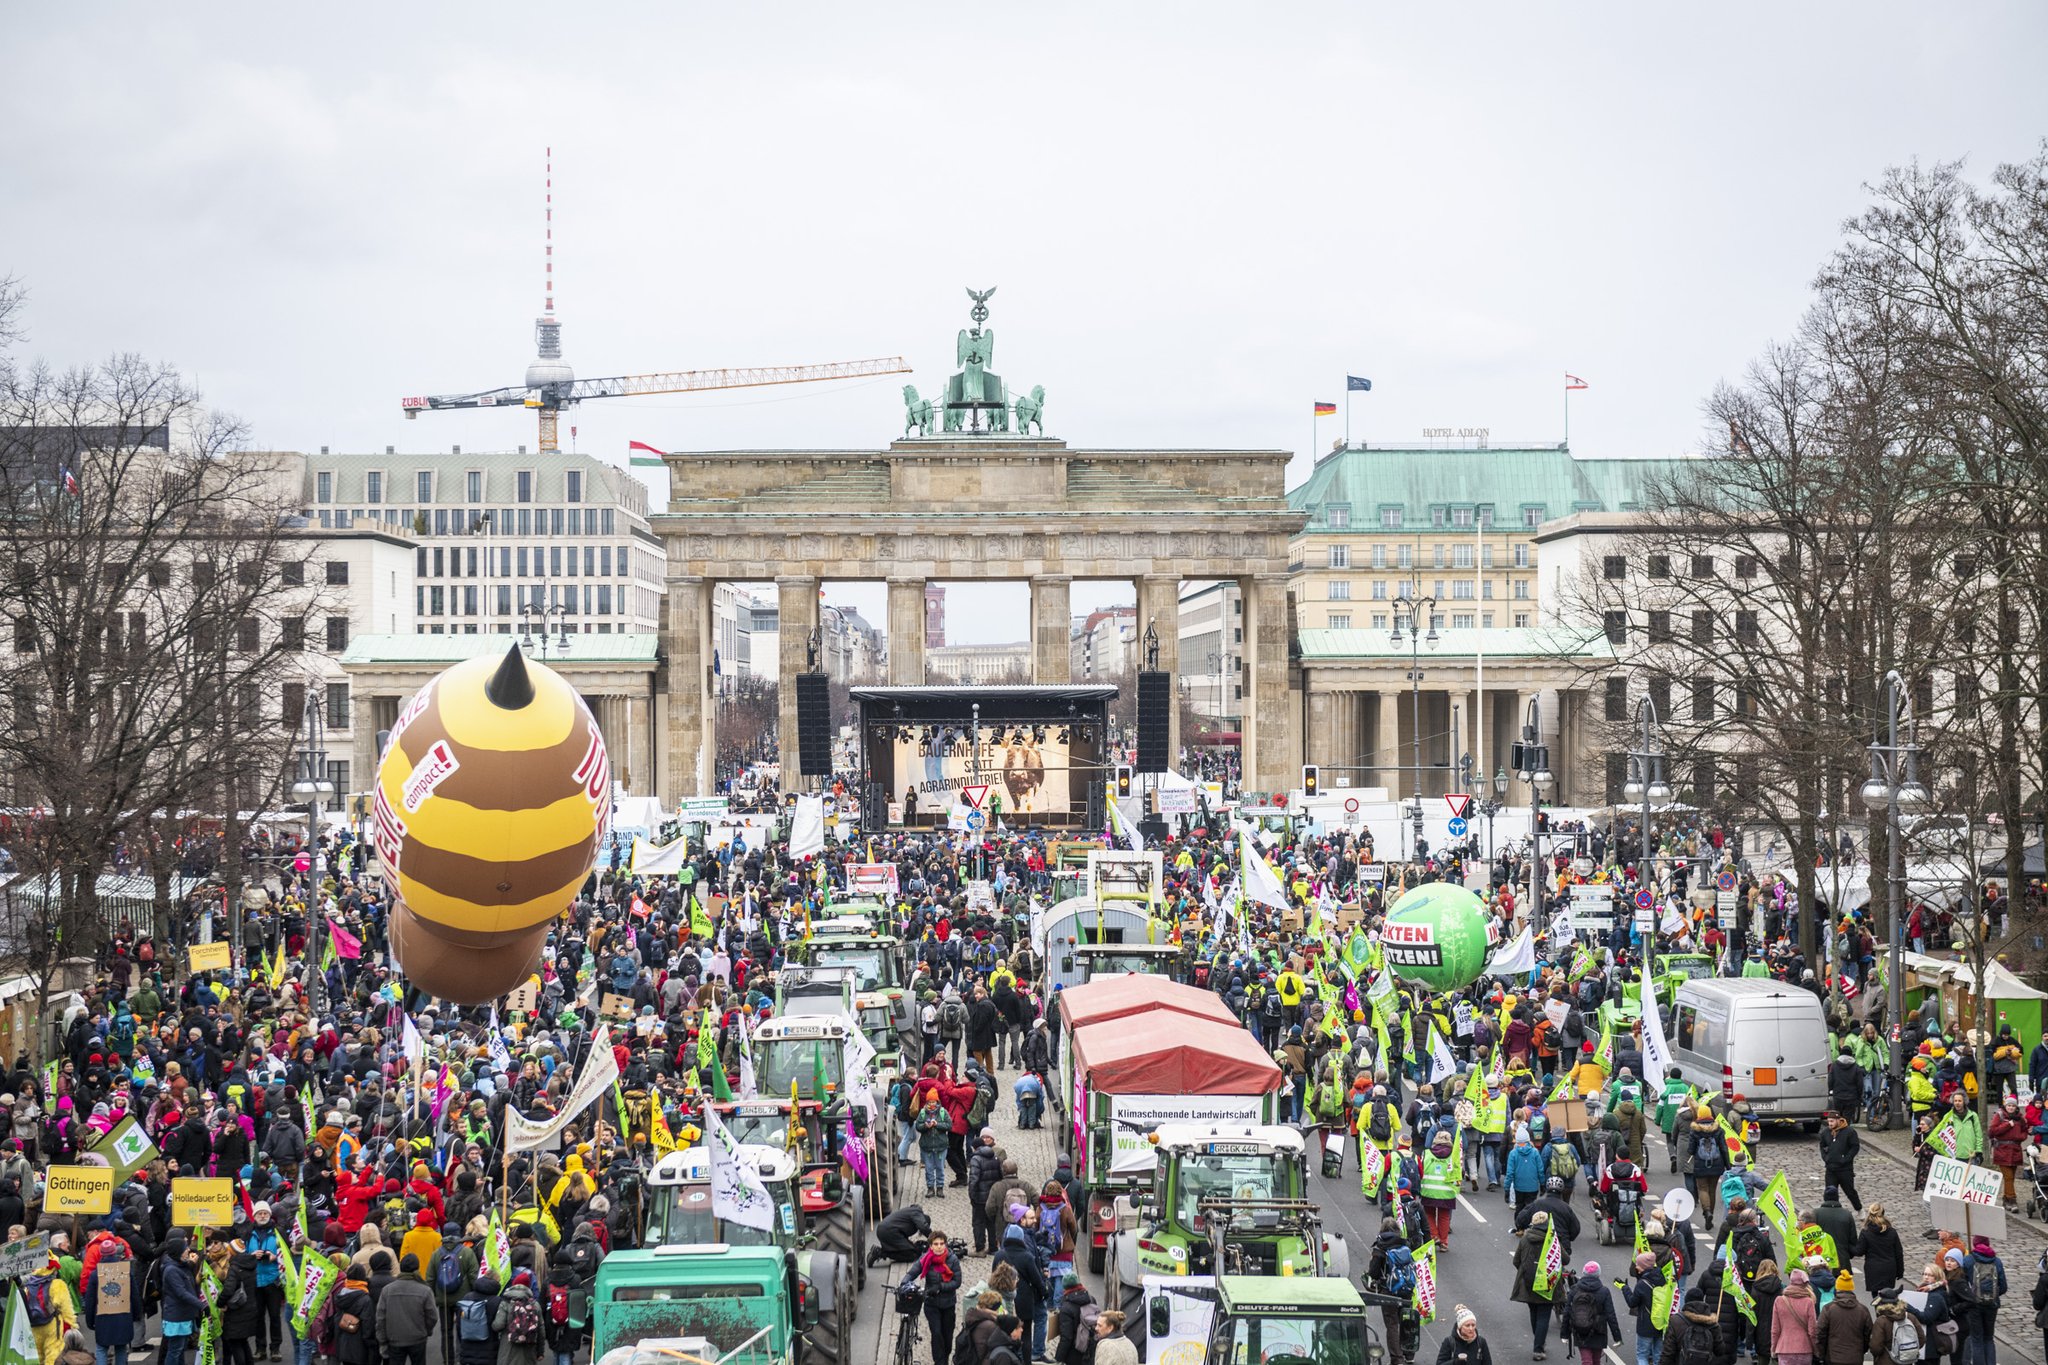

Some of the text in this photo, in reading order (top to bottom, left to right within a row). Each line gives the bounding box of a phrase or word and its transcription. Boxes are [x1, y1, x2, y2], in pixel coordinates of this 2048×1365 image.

[1423, 428, 1489, 438] HOTEL ADLON
[406, 745, 452, 809] campact!
[191, 945, 228, 955] Forchheim
[768, 1106, 778, 1114] 75
[1117, 1109, 1257, 1119] Klimaschonende Landwirtschaft
[654, 1127, 673, 1147] NEIN
[1117, 1138, 1137, 1150] Wir
[1214, 1144, 1257, 1154] GR GK 444
[1933, 1161, 1998, 1196] ÖKO Anbau
[50, 1176, 110, 1194] Göttingen
[1939, 1182, 1957, 1196] für
[175, 1193, 231, 1203] Holledauer Eck
[1101, 1208, 1112, 1218] 40
[1172, 1248, 1185, 1259] 50
[1236, 1304, 1298, 1312] DEUTZ-FAHR
